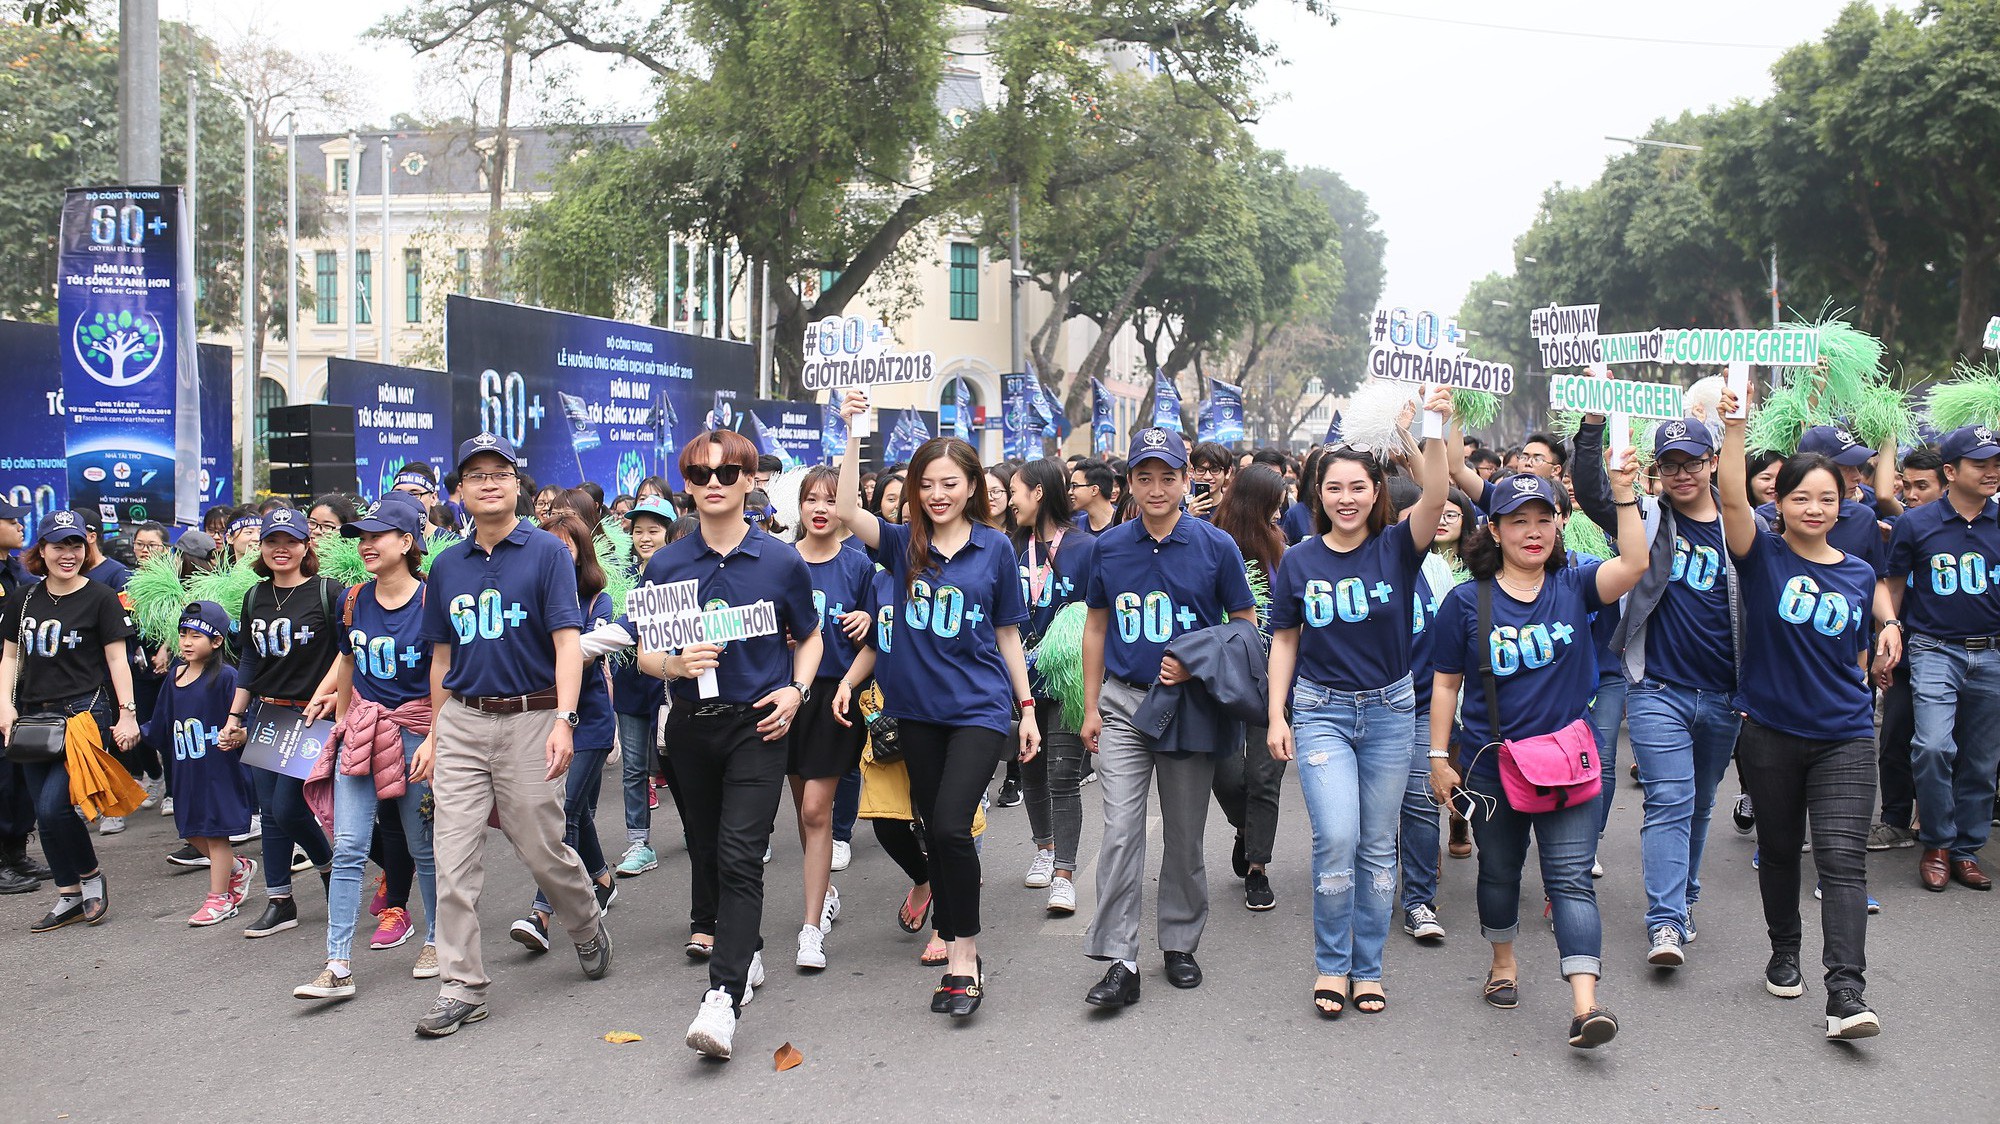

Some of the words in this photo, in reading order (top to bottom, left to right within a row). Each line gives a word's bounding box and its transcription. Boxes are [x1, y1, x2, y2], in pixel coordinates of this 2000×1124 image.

[100, 192, 123, 200] CÔNG
[92, 204, 167, 245] 60+
[66, 274, 83, 286] TÔI
[85, 274, 113, 286] SỐNG
[115, 277, 146, 288] XANH
[148, 278, 170, 288] HƠN
[93, 263, 118, 274] HÔM
[121, 265, 145, 276] NAY
[92, 286, 103, 294] Go
[125, 287, 148, 296] Green
[805, 316, 884, 356] #60+
[1374, 307, 1461, 350] #60+
[1532, 306, 1597, 337] #HÔMNAY
[606, 335, 615, 351] BỘ
[615, 337, 631, 350] CÔNG
[1664, 331, 1818, 363] #GOMOREGREEN
[557, 347, 567, 366] LỄ
[568, 350, 593, 369] HƯỞNG
[594, 354, 609, 370] ỨNG
[610, 355, 628, 372] CHIẾN
[629, 360, 644, 375] DỊCH
[644, 360, 655, 375] GIỜ
[669, 363, 681, 378] ĐẤT
[680, 367, 693, 379] 2018
[804, 349, 932, 388] GIỜTRÁIĐẤT2018
[1373, 346, 1511, 393] GIỜTRÁIĐẤT2018
[378, 382, 396, 403] HÔM
[397, 387, 414, 405] NAY
[610, 377, 630, 399] HÔM
[632, 382, 651, 400] NAY
[1555, 377, 1683, 418] #GOMOREGREEN
[358, 406, 372, 427] TÔI
[373, 403, 394, 428] SỐNG
[395, 412, 416, 429] XANH
[417, 413, 433, 430] HƠN
[480, 368, 545, 449] 60+
[588, 402, 602, 424] TÔI
[604, 400, 627, 424] SỐNG
[378, 432, 387, 445] Go
[388, 433, 402, 445] More
[402, 432, 418, 445] Green
[610, 428, 619, 441] Go
[620, 429, 635, 441] More
[636, 428, 654, 441] Green
[1, 457, 13, 471] BỘ
[14, 457, 36, 469] CÔNG
[36, 459, 67, 469] THƯƠNG
[450, 588, 528, 646] 60+
[628, 582, 697, 618] #HÔMNAY
[905, 578, 985, 639] 60+
[1115, 590, 1197, 644] 60+
[1303, 577, 1393, 628] 60+
[1778, 574, 1862, 637] 60+
[22, 616, 82, 658] 60+
[251, 617, 315, 658] 60+
[639, 603, 774, 651] TÔISỐNGXANHHƠN
[349, 629, 421, 680] 60+
[1489, 620, 1575, 677] 60+
[173, 717, 220, 761] 60+
[258, 721, 276, 745] 60+
